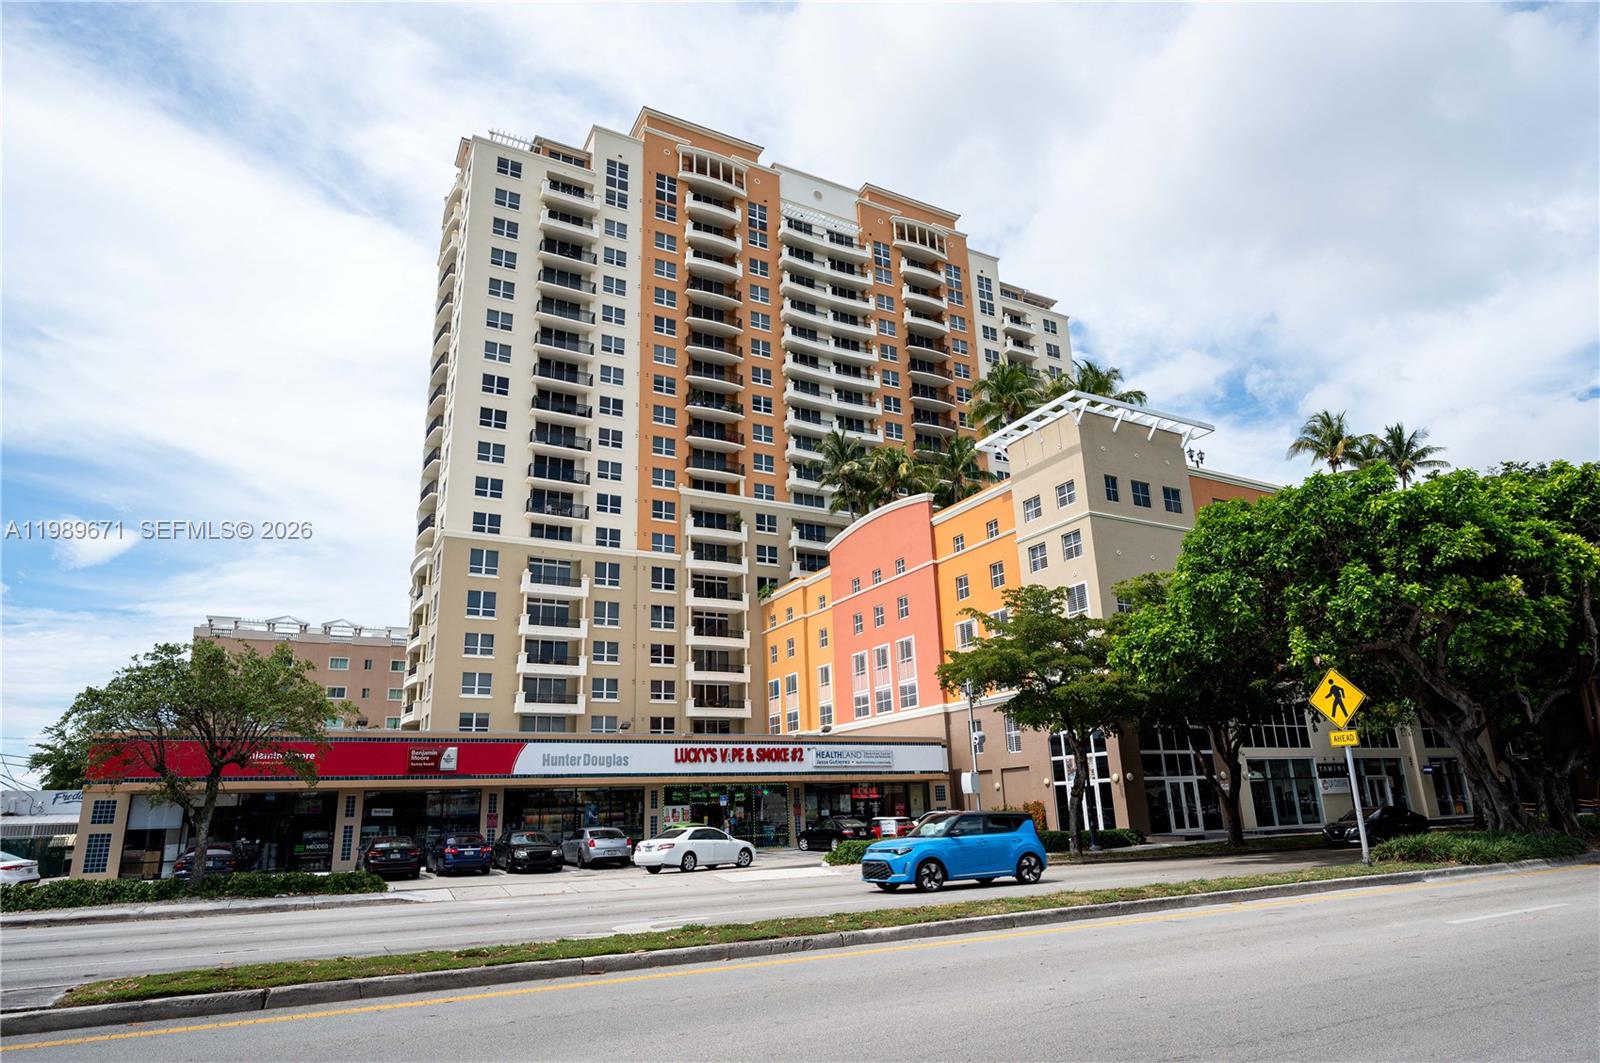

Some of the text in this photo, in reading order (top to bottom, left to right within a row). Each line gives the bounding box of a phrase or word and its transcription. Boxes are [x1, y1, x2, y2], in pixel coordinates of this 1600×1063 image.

[1333, 734, 1355, 743] AHEAD
[542, 753, 630, 768] Hunter Douglas
[674, 747, 804, 763] LUCKY'S VPE & SMOKE #2
[815, 751, 862, 759] HEALTHLAND
